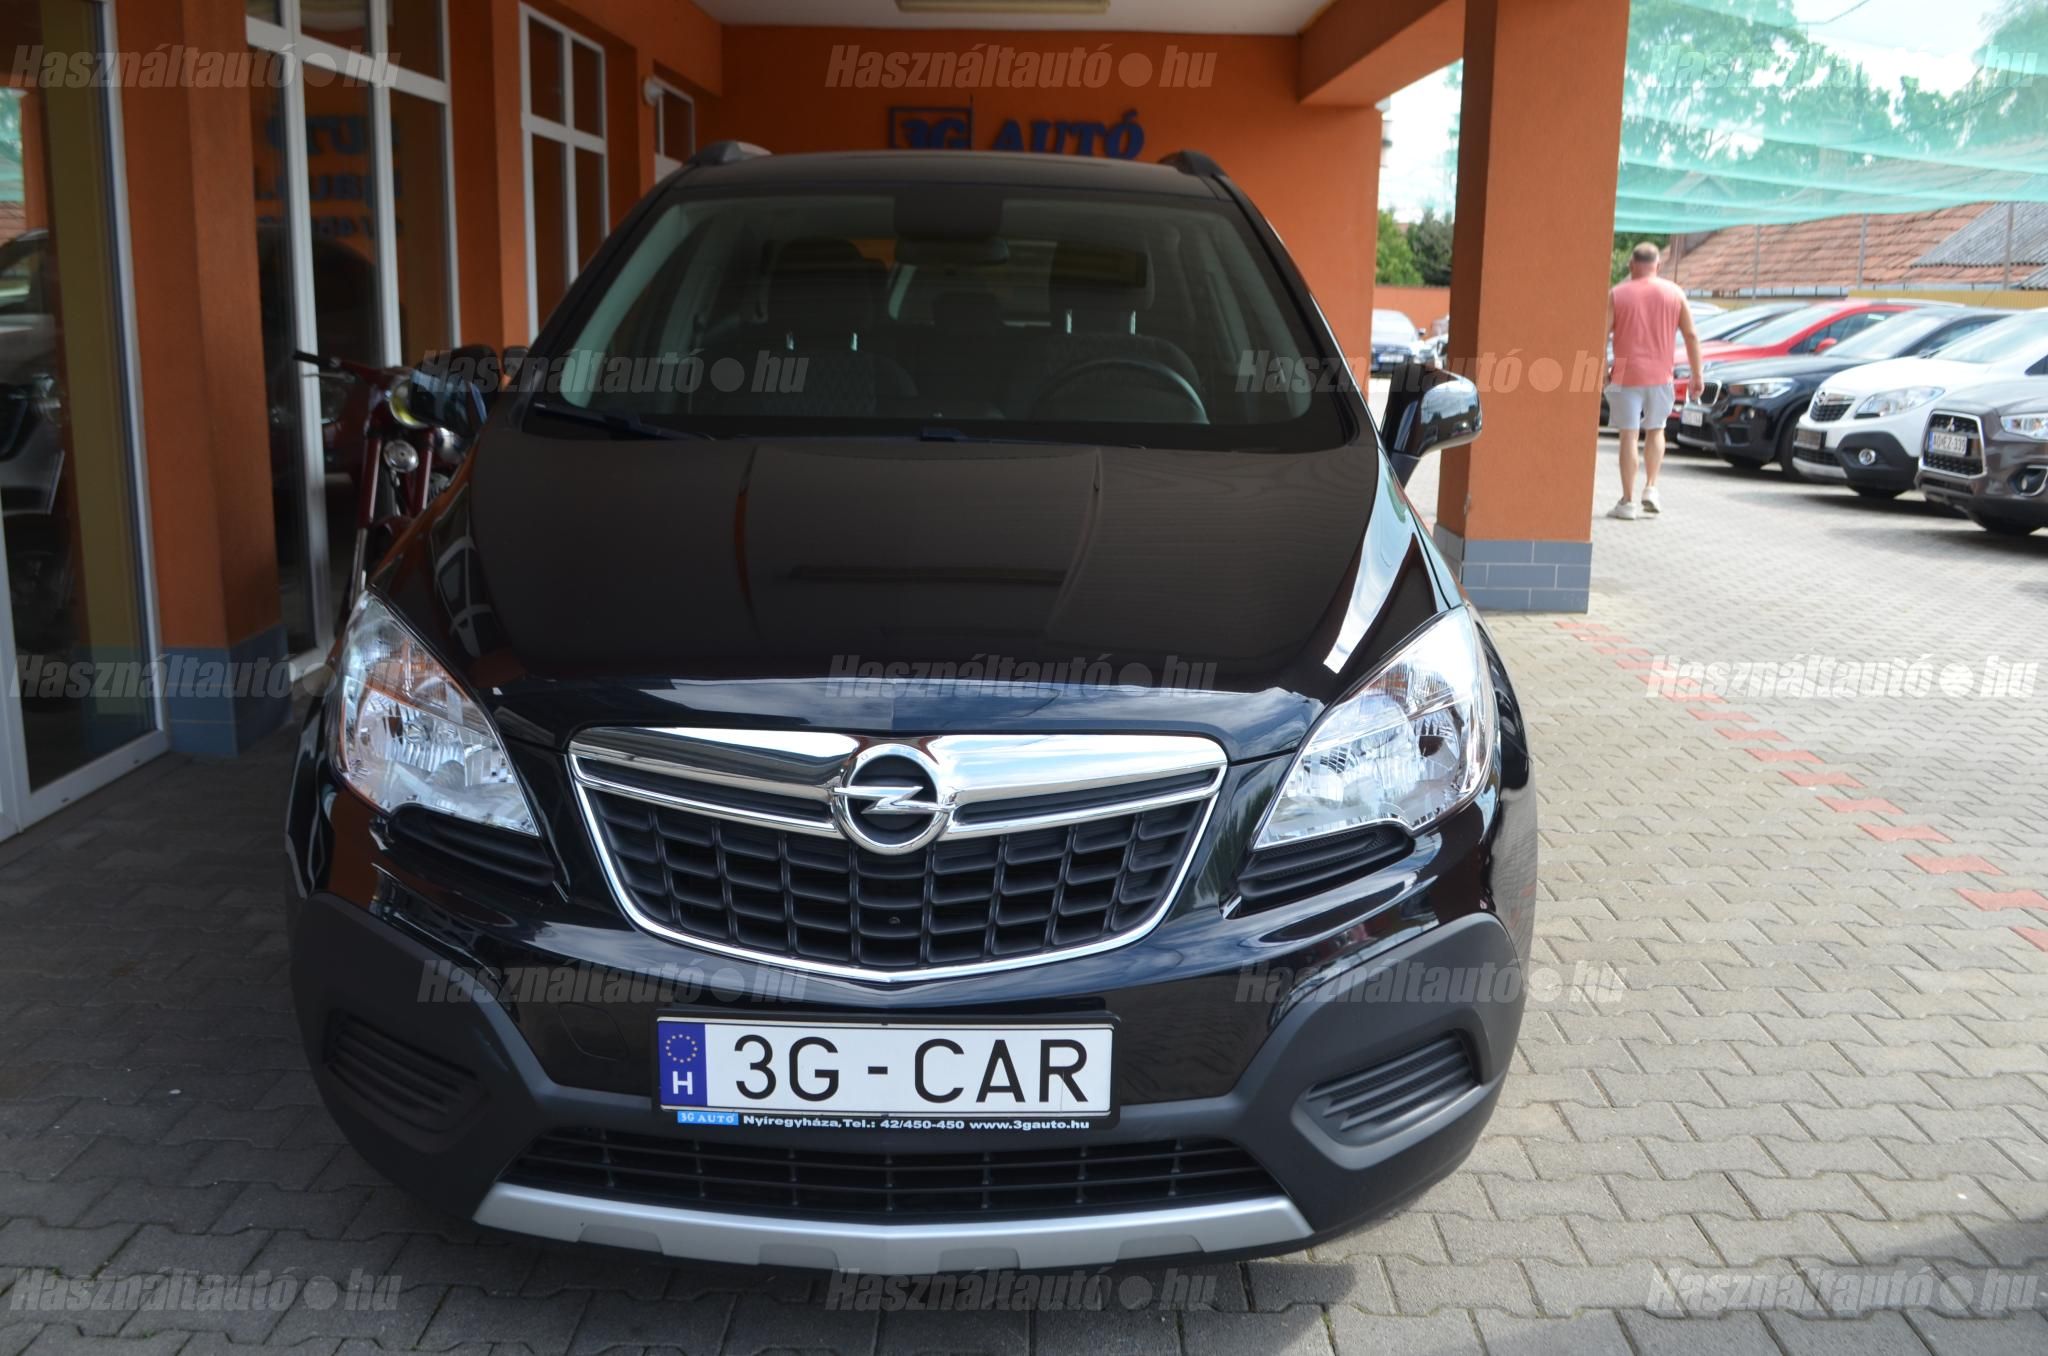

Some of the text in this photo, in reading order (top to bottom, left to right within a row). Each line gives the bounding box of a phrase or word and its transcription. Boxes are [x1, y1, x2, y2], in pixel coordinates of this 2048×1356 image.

[992, 108, 1144, 160] AUTÓ
[673, 1071, 693, 1094] H
[880, 1119, 965, 1129] 42/450-450
[969, 1119, 1090, 1130] www.3gauto.hu
